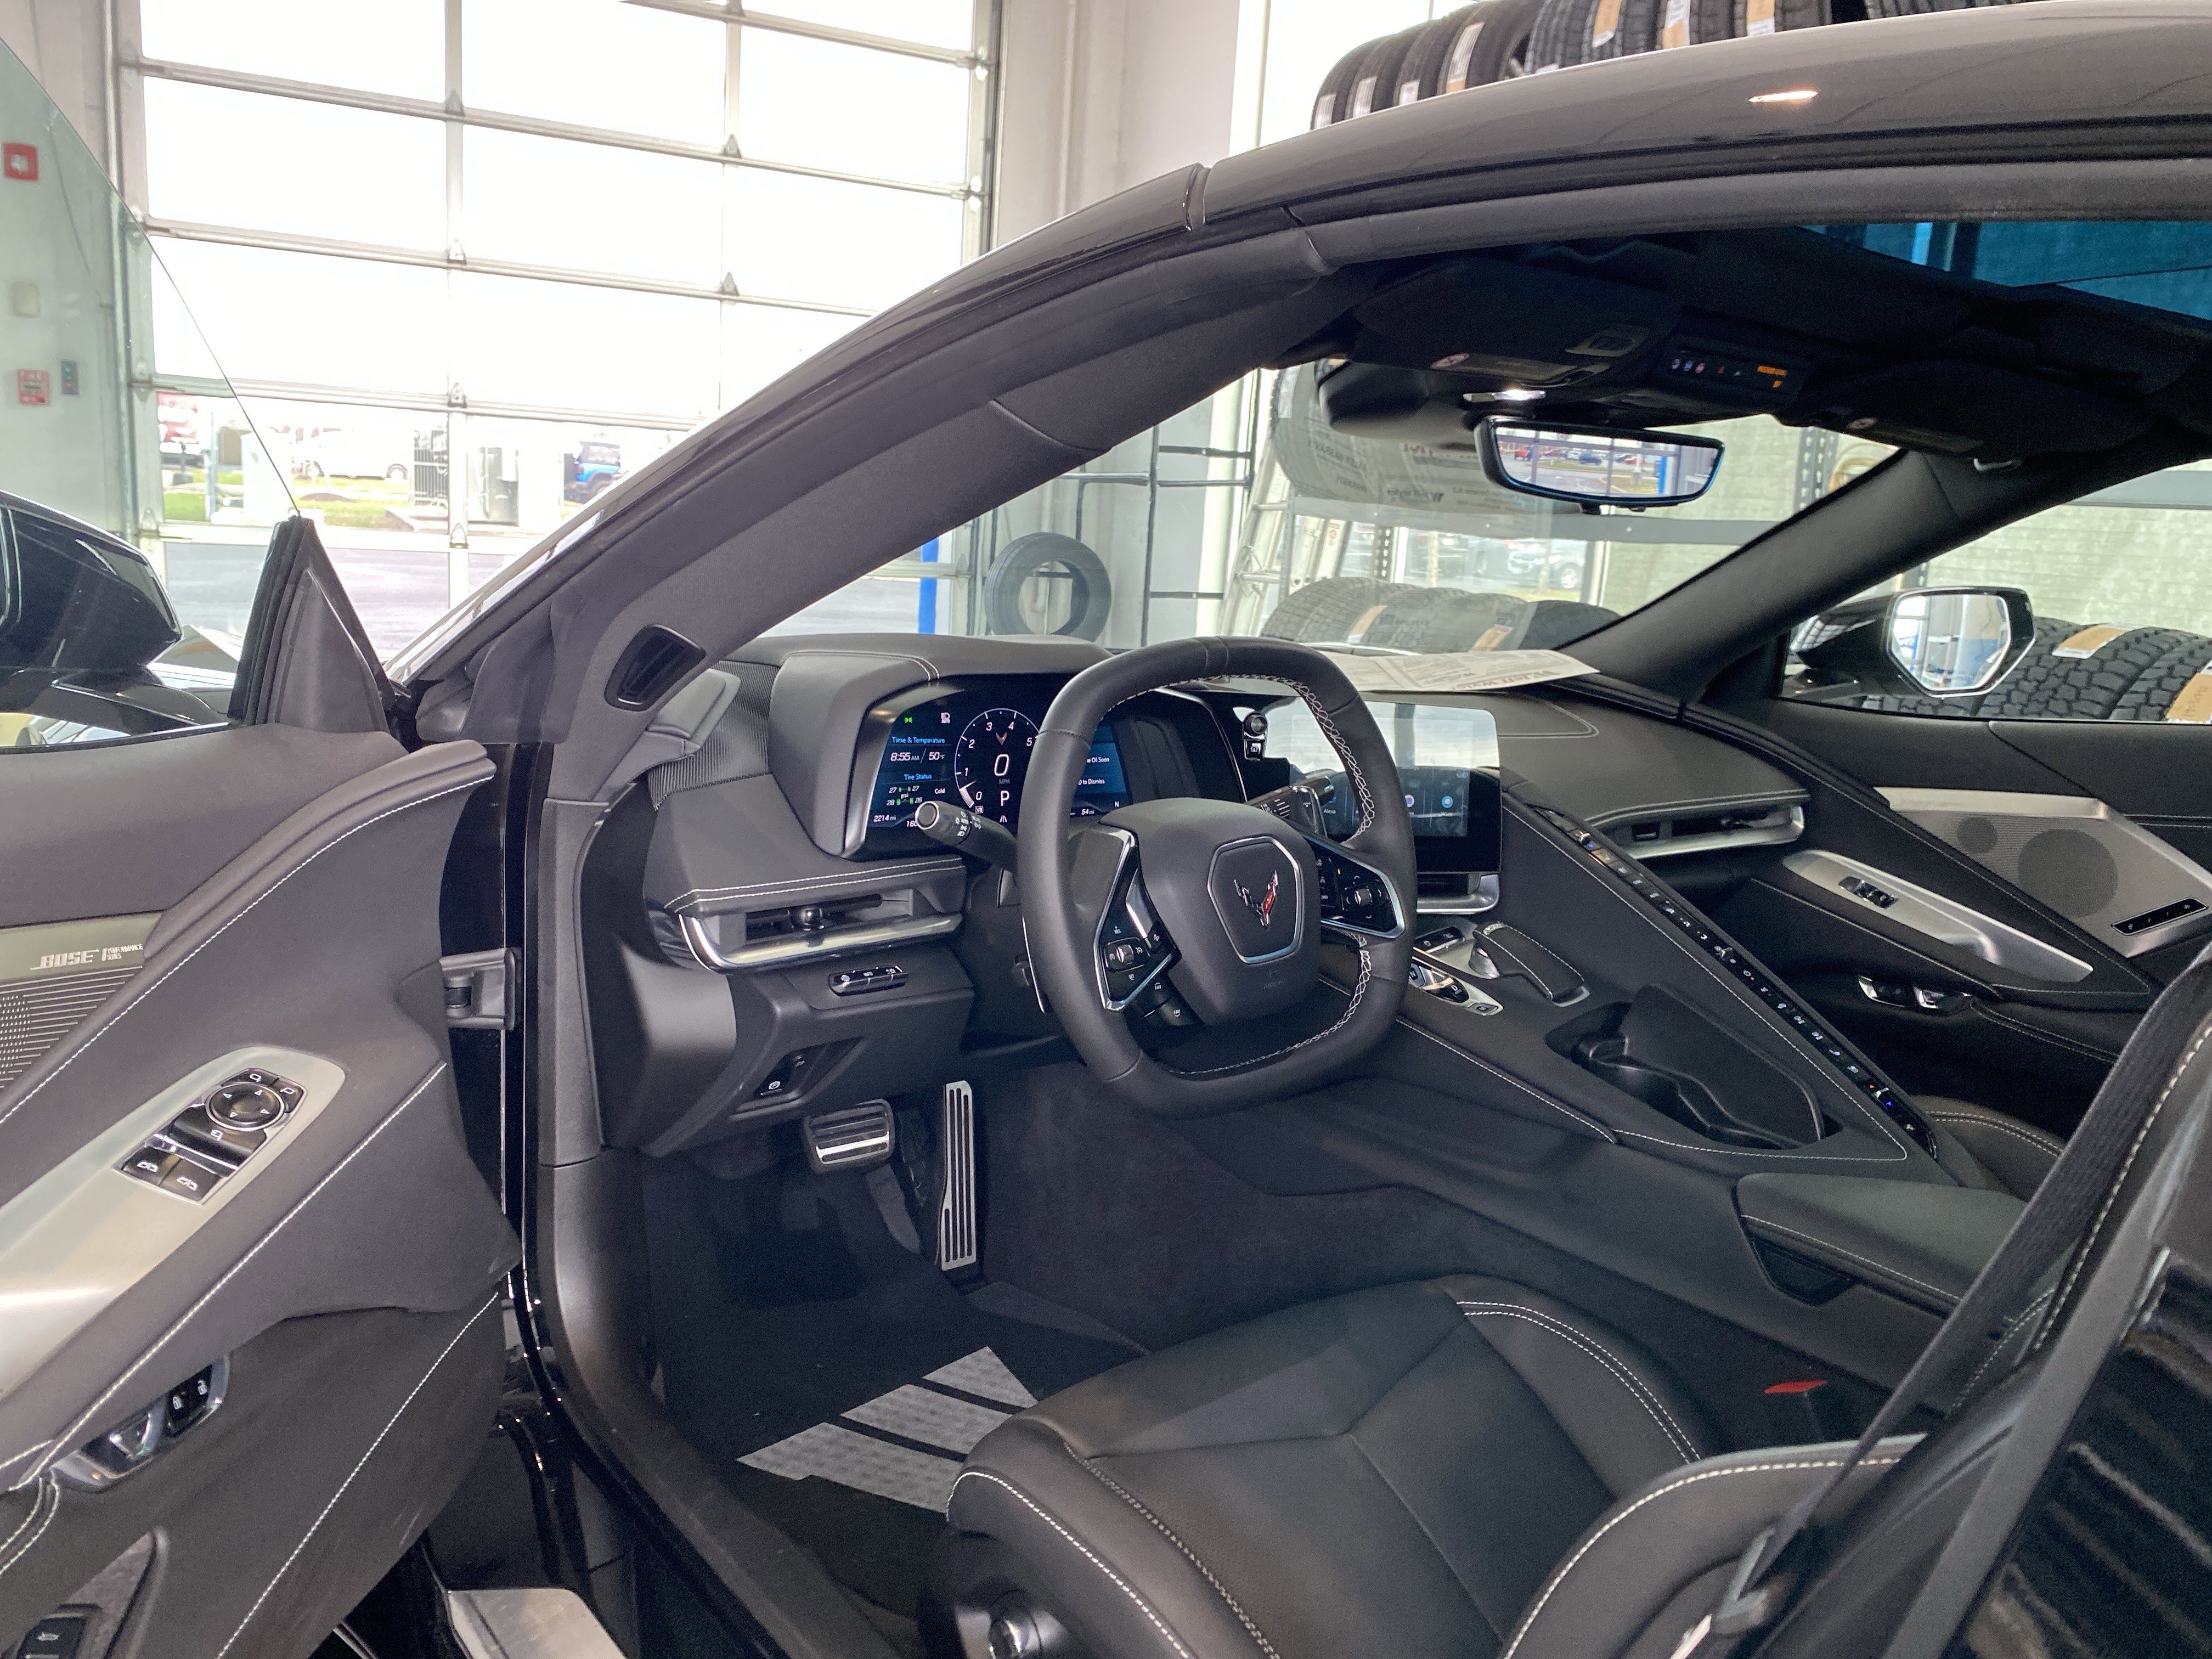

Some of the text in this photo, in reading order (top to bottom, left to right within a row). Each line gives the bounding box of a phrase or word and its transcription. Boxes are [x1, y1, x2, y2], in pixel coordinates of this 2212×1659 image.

[986, 722, 992, 731] 3
[1008, 721, 1014, 730] 4
[912, 736, 945, 744] Temperature
[968, 739, 975, 748] 2
[1026, 737, 1032, 746] 5
[890, 752, 911, 761] 8:55
[994, 753, 1009, 776] 0
[964, 768, 968, 776] 1
[975, 791, 983, 800] 0
[1000, 790, 1009, 806] P
[873, 814, 889, 822] 2214
[30, 949, 99, 970] BOSE
